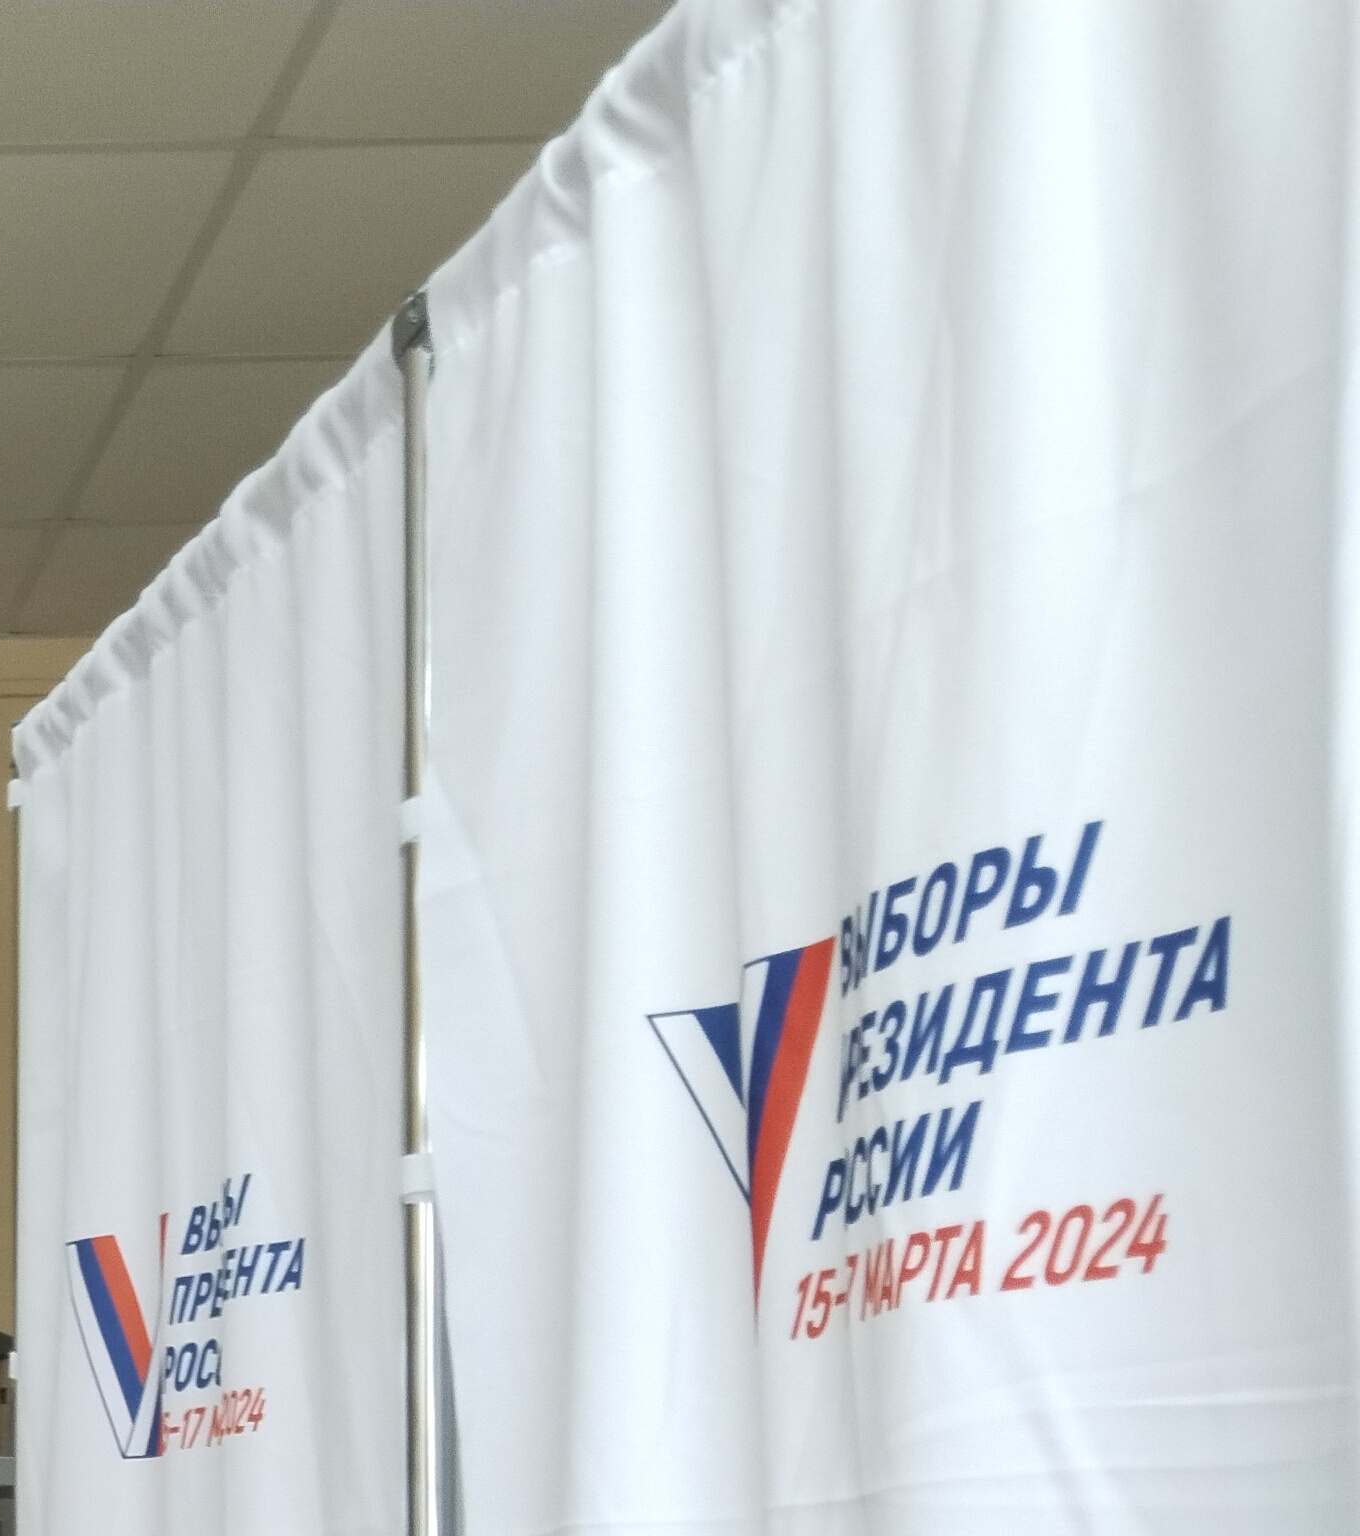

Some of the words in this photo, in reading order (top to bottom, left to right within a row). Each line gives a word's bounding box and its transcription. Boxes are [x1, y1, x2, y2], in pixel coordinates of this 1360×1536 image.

[836, 914, 1231, 1123] РЕЗИДЕНТА
[811, 1099, 984, 1242] РССИИ
[169, 1237, 306, 1326] ПРЕЕНТА
[1000, 1193, 1169, 1294] 2024
